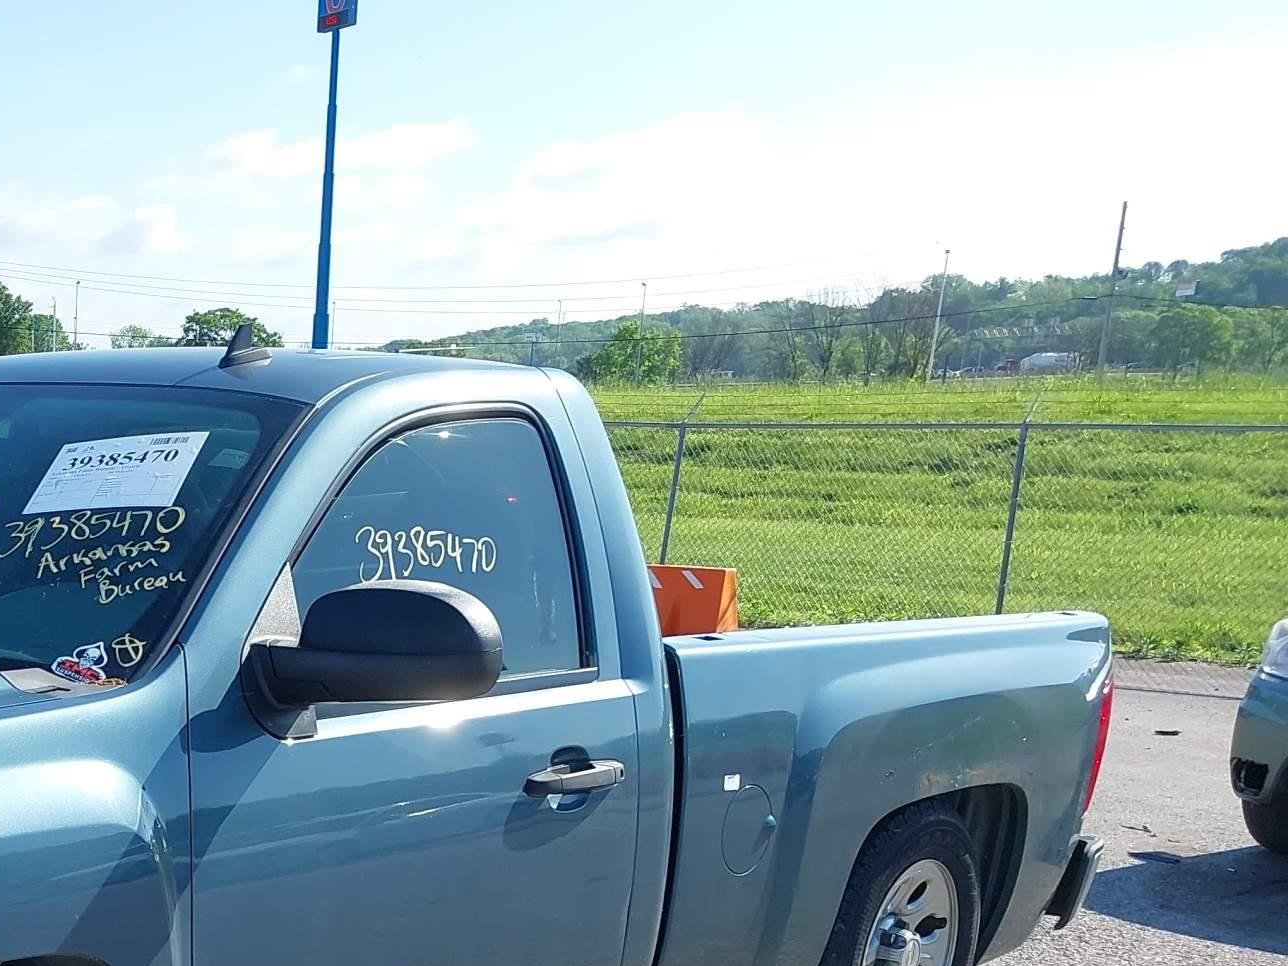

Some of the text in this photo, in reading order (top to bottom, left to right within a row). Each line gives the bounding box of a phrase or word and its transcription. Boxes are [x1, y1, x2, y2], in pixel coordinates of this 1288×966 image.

[62, 448, 180, 472] 39385470
[37, 535, 171, 579] Arkansas
[354, 525, 498, 583] 39385470
[78, 557, 159, 589] Farm
[97, 569, 188, 605] Bureau
